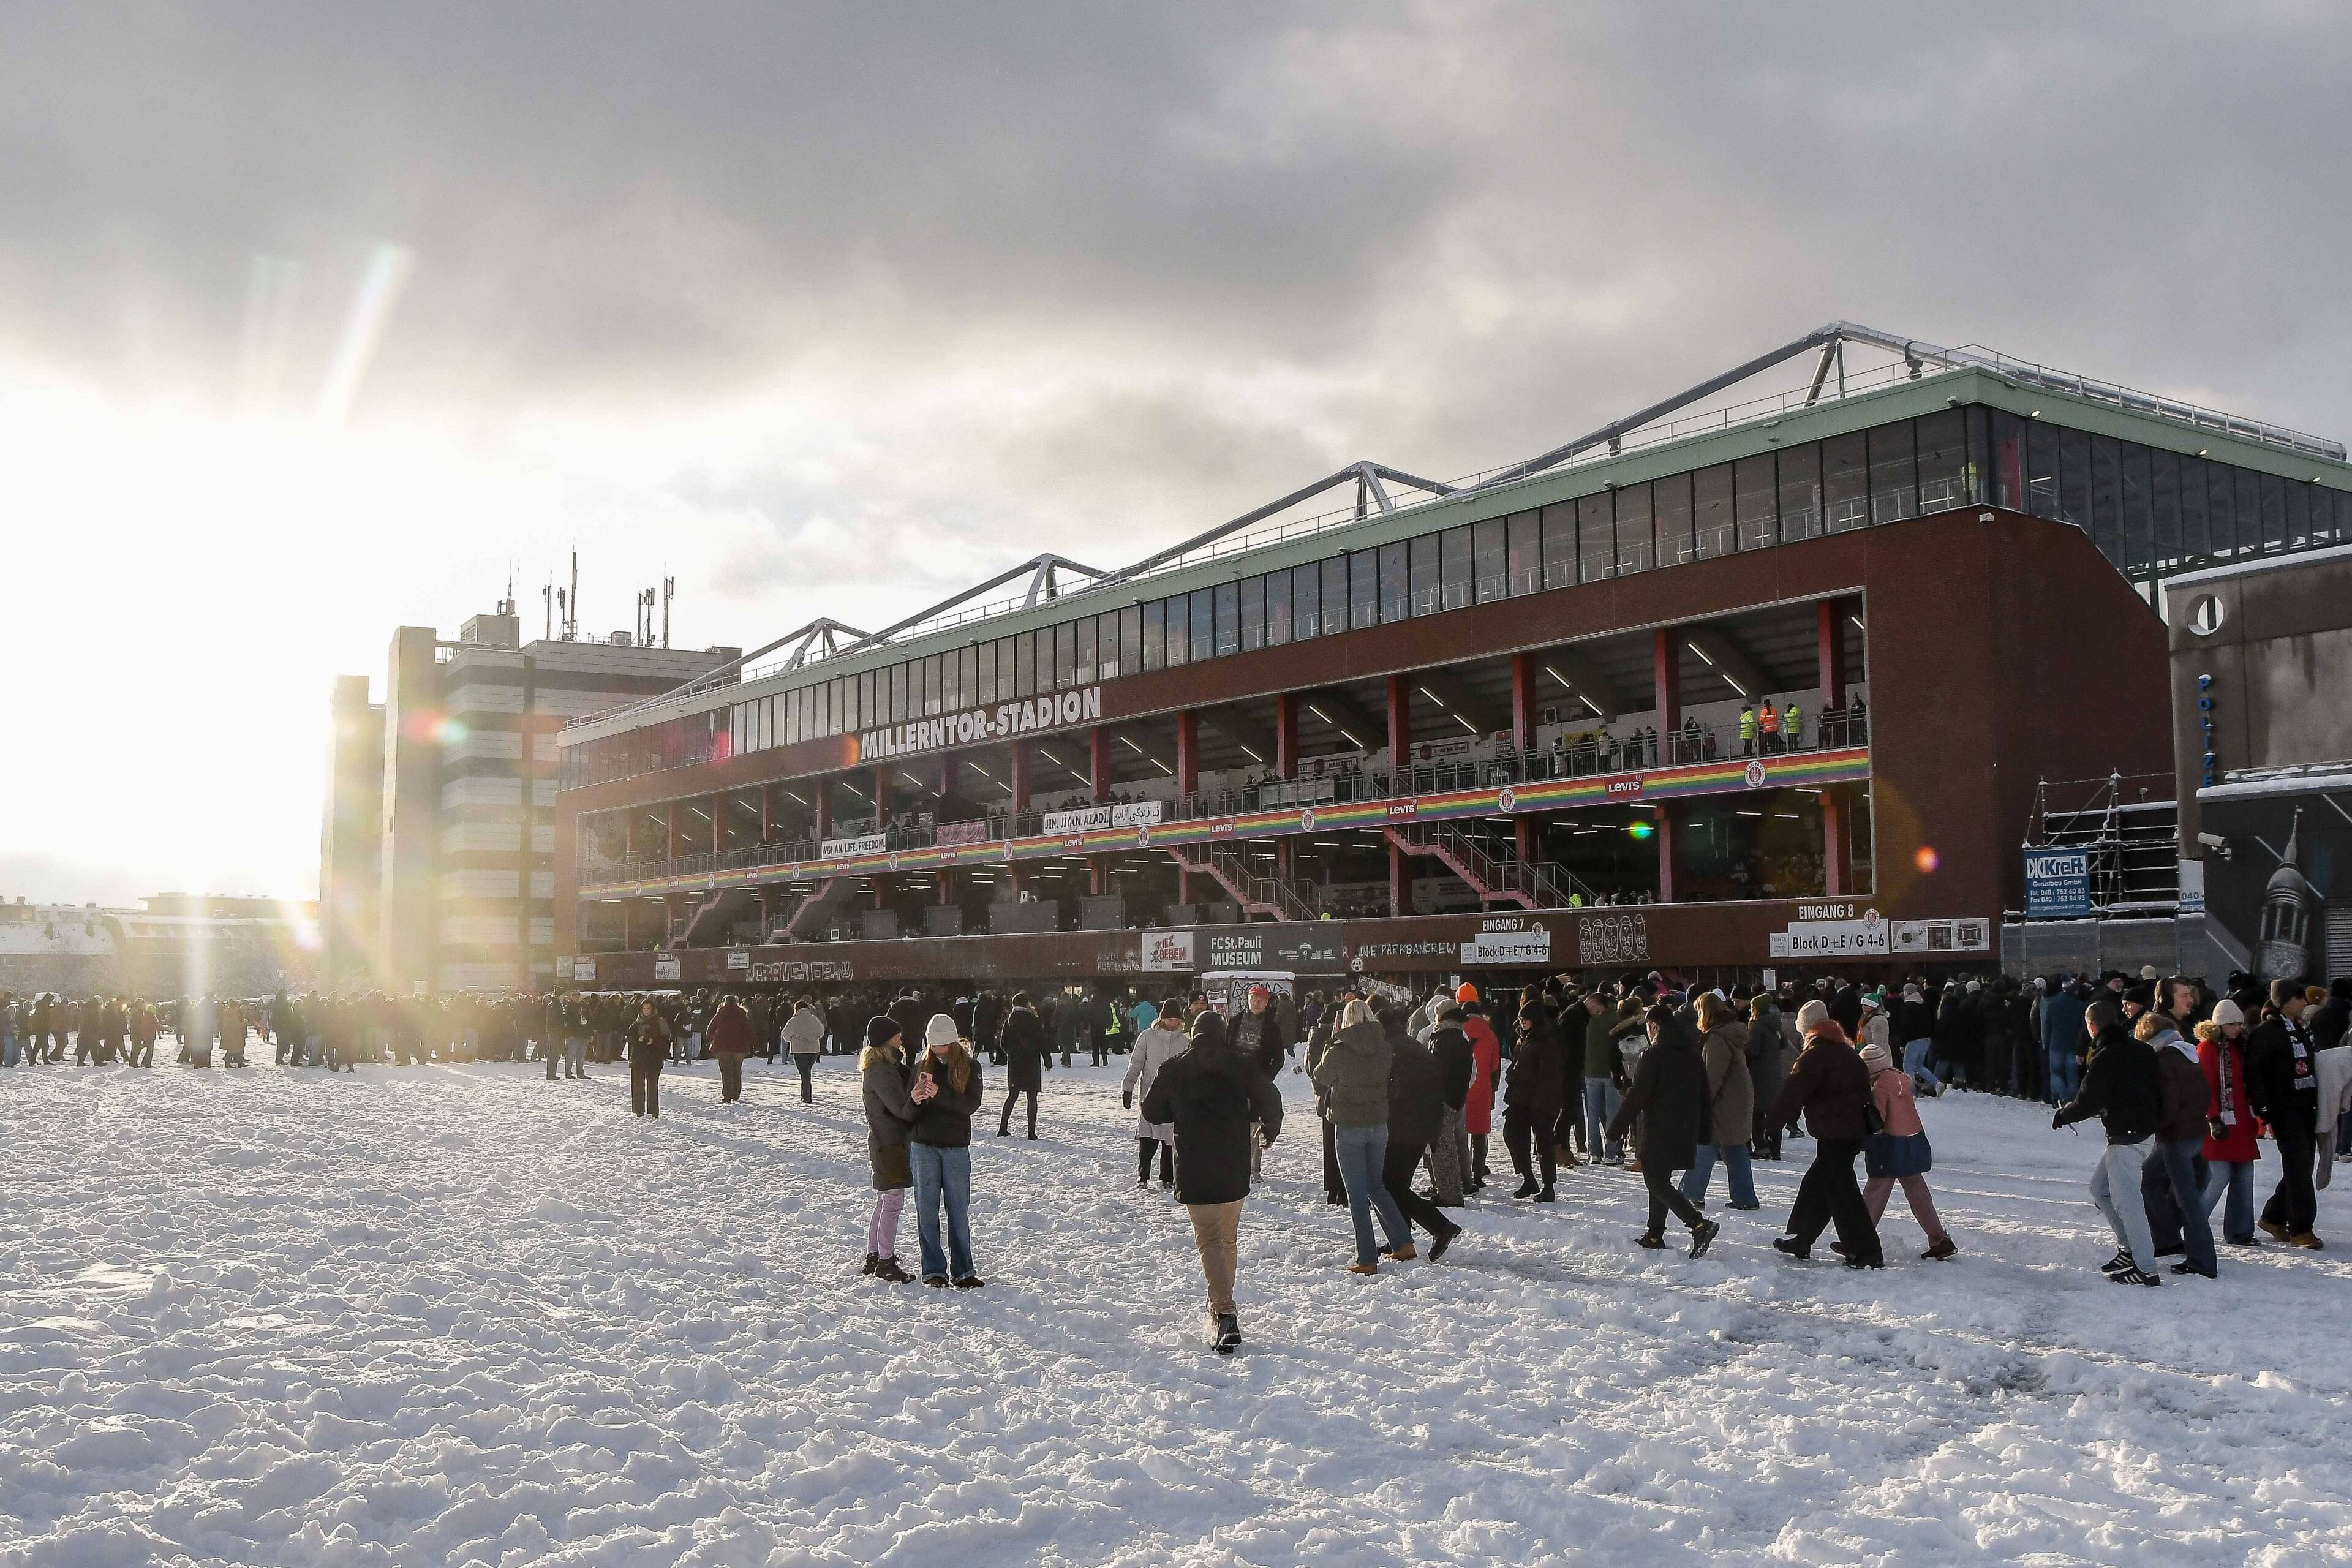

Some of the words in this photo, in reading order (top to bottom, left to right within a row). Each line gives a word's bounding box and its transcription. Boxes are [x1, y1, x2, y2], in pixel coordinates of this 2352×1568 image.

[861, 687, 1101, 760] MILLERNTOR-STADION
[1798, 905, 1844, 919] EINGANG
[1847, 903, 1854, 918] 8
[1482, 919, 1517, 931] EINGANG
[1519, 919, 1525, 930] 7
[1155, 935, 1174, 949] KIEZ
[1211, 937, 1223, 949] FC
[1792, 935, 1819, 949] Block
[1856, 934, 1864, 948] G
[1868, 933, 1885, 947] 4-6
[1160, 947, 1186, 960] BEBEN
[1478, 945, 1498, 957] Block
[1525, 944, 1531, 956] G
[1534, 944, 1547, 956] 4-6
[1211, 952, 1262, 965] MUSEUM
